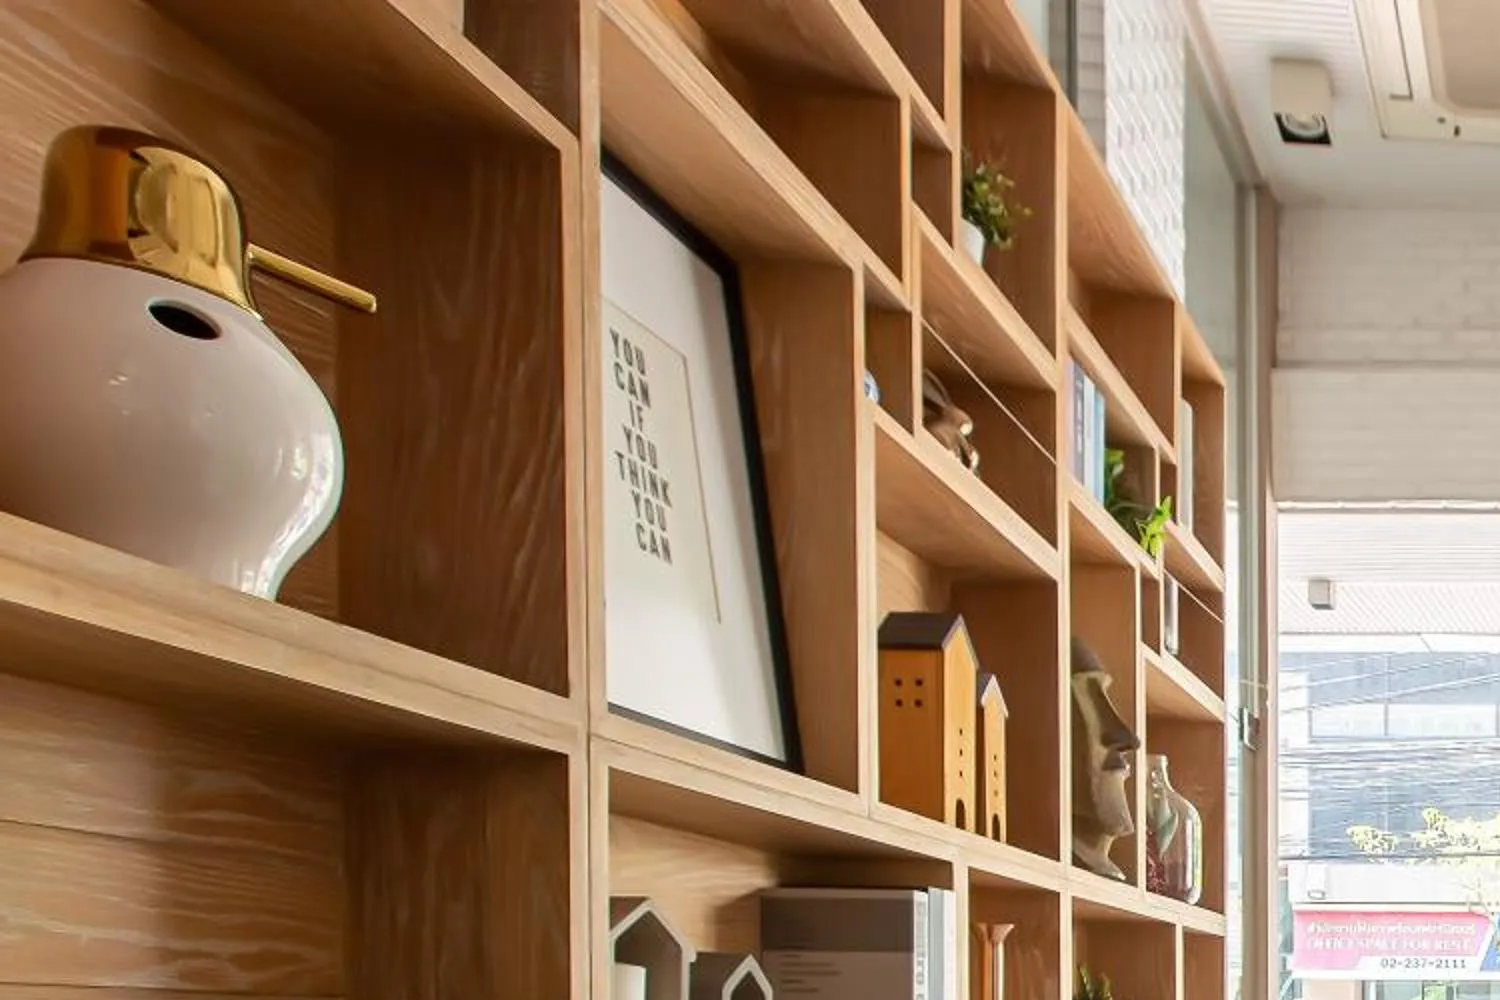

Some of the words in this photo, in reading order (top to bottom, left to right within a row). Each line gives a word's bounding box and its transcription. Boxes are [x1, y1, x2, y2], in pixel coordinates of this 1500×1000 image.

[609, 327, 647, 377] YOU
[613, 362, 651, 408] CAN
[628, 400, 645, 430] IF
[622, 423, 658, 470] YOU
[614, 450, 672, 508] THINK
[631, 489, 667, 533] YOU
[635, 523, 673, 565] CAN
[1380, 957, 1467, 969] 02-237-2111
